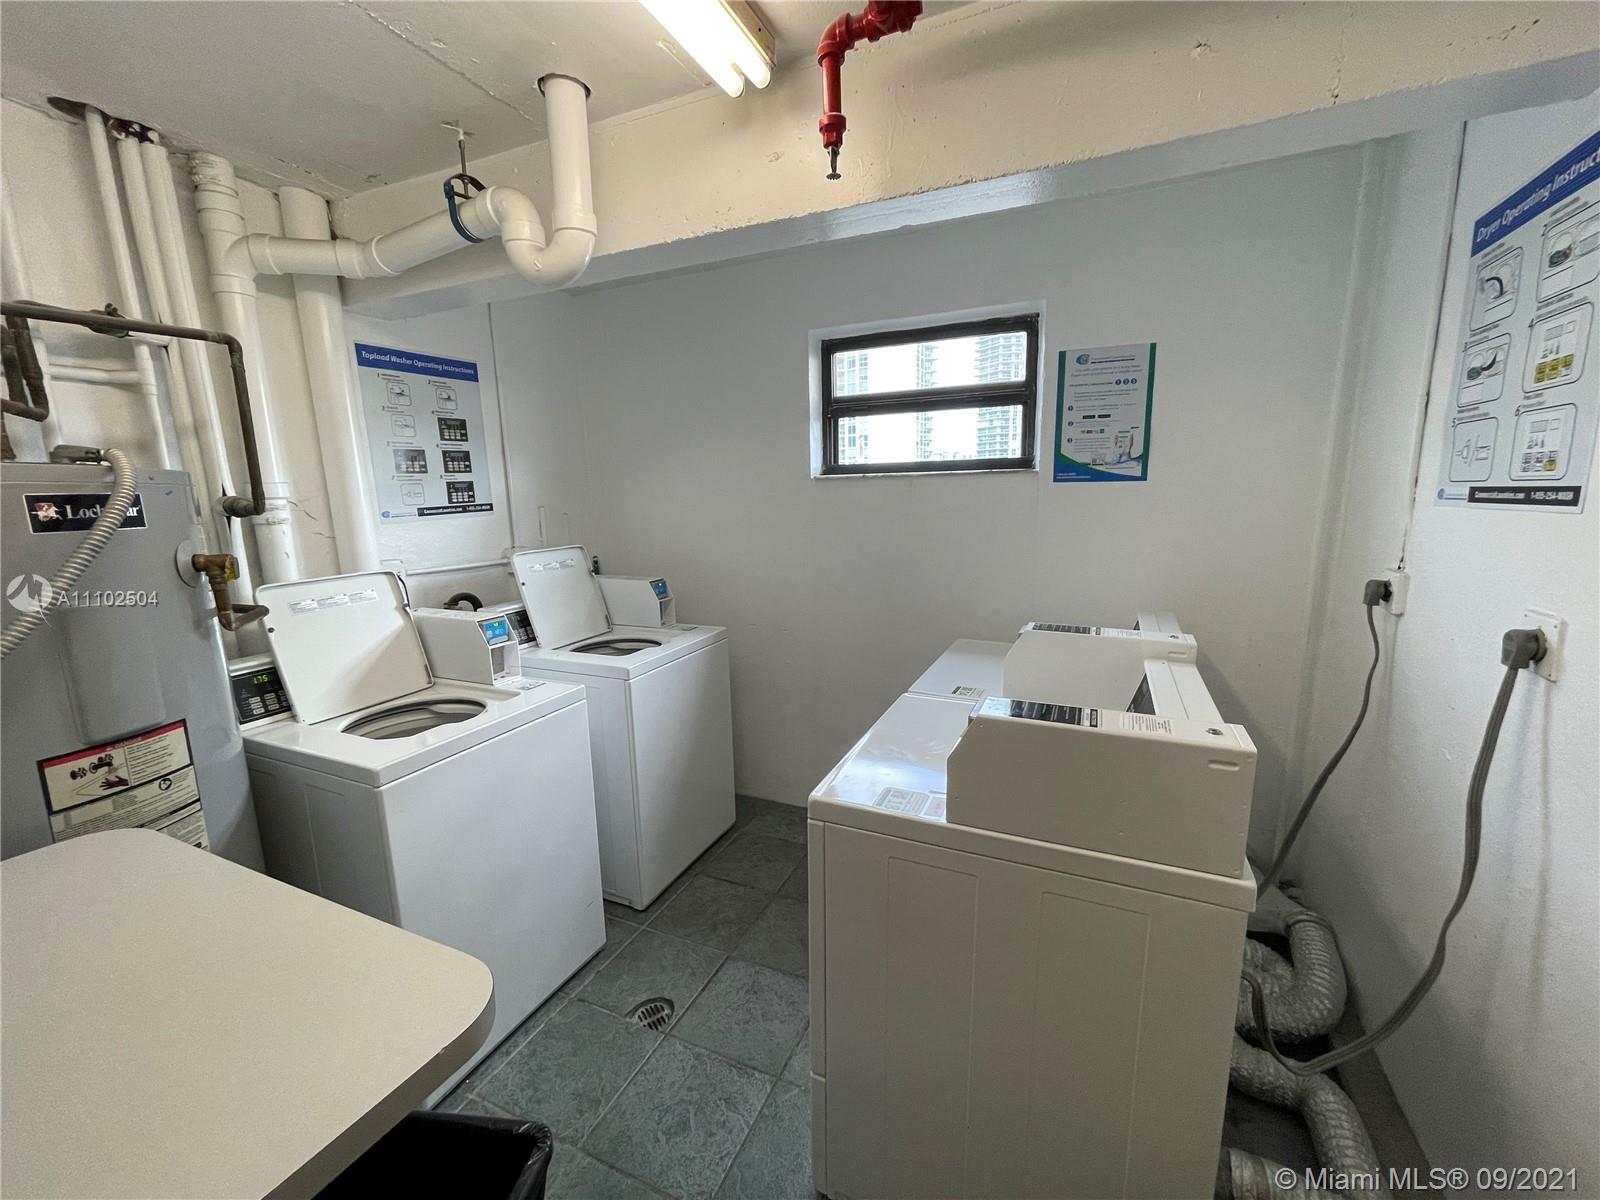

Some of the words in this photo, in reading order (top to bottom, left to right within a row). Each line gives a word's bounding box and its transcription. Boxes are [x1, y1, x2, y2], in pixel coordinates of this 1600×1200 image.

[1476, 219, 1502, 243] Dryer
[1502, 183, 1553, 225] Operating
[361, 350, 390, 362] Topload
[391, 355, 413, 365] Washer
[413, 359, 443, 371] Operating
[443, 363, 474, 375] Instructions
